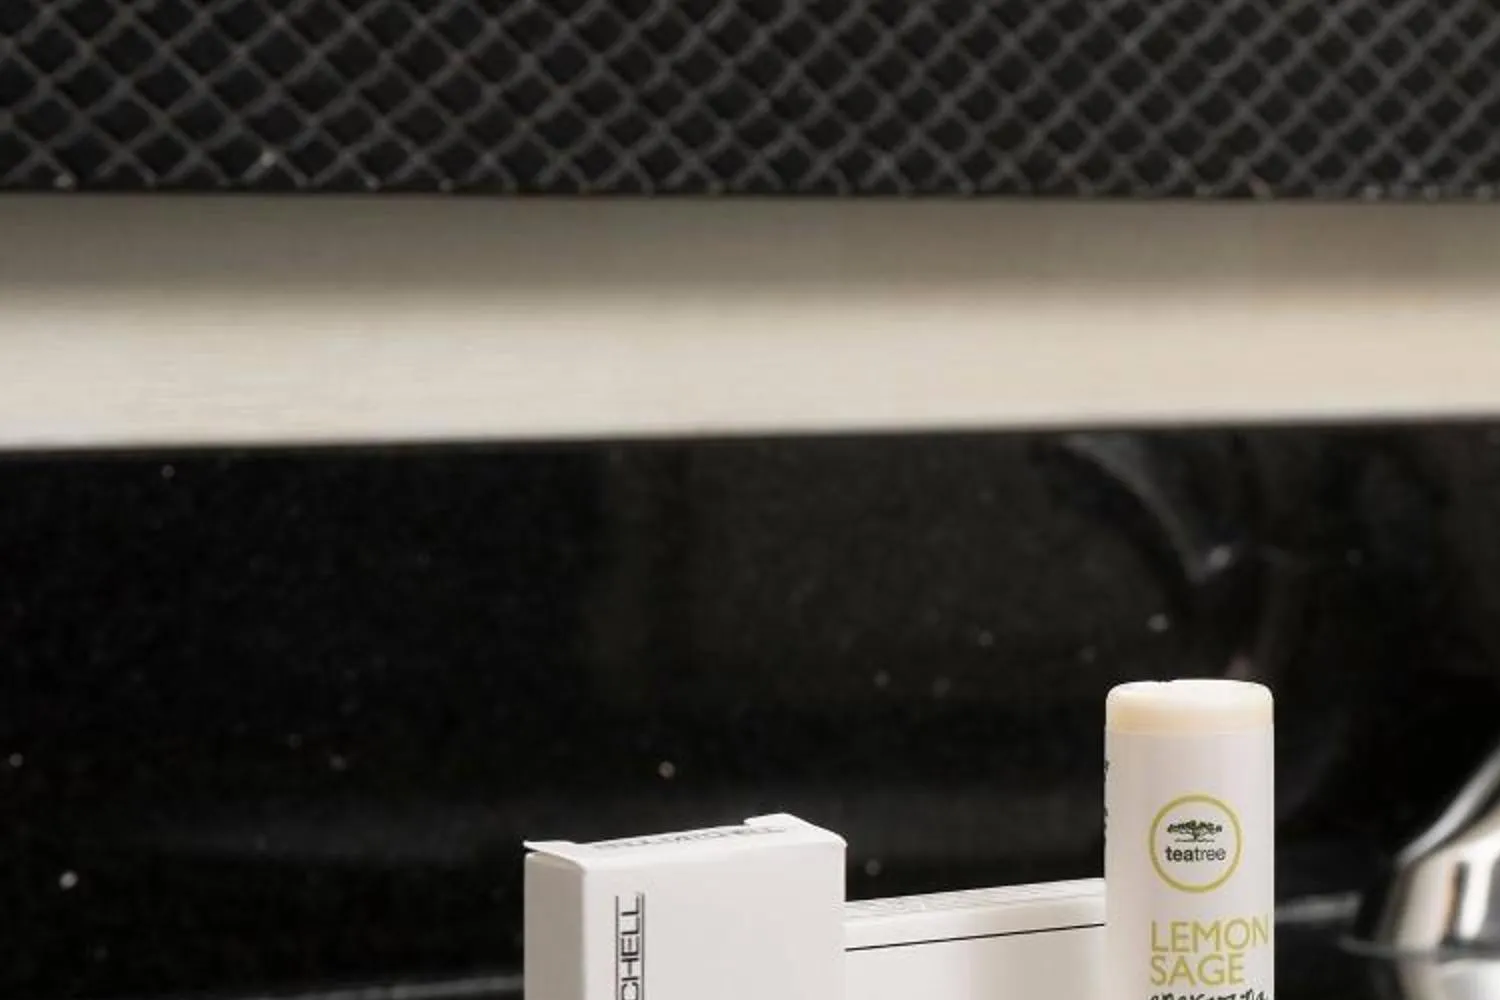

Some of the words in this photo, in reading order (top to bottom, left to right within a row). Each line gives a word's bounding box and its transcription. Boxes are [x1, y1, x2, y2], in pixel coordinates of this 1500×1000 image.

[1165, 845, 1226, 863] teatree
[1151, 914, 1269, 954] LEMON
[1150, 953, 1245, 987] SAGE
